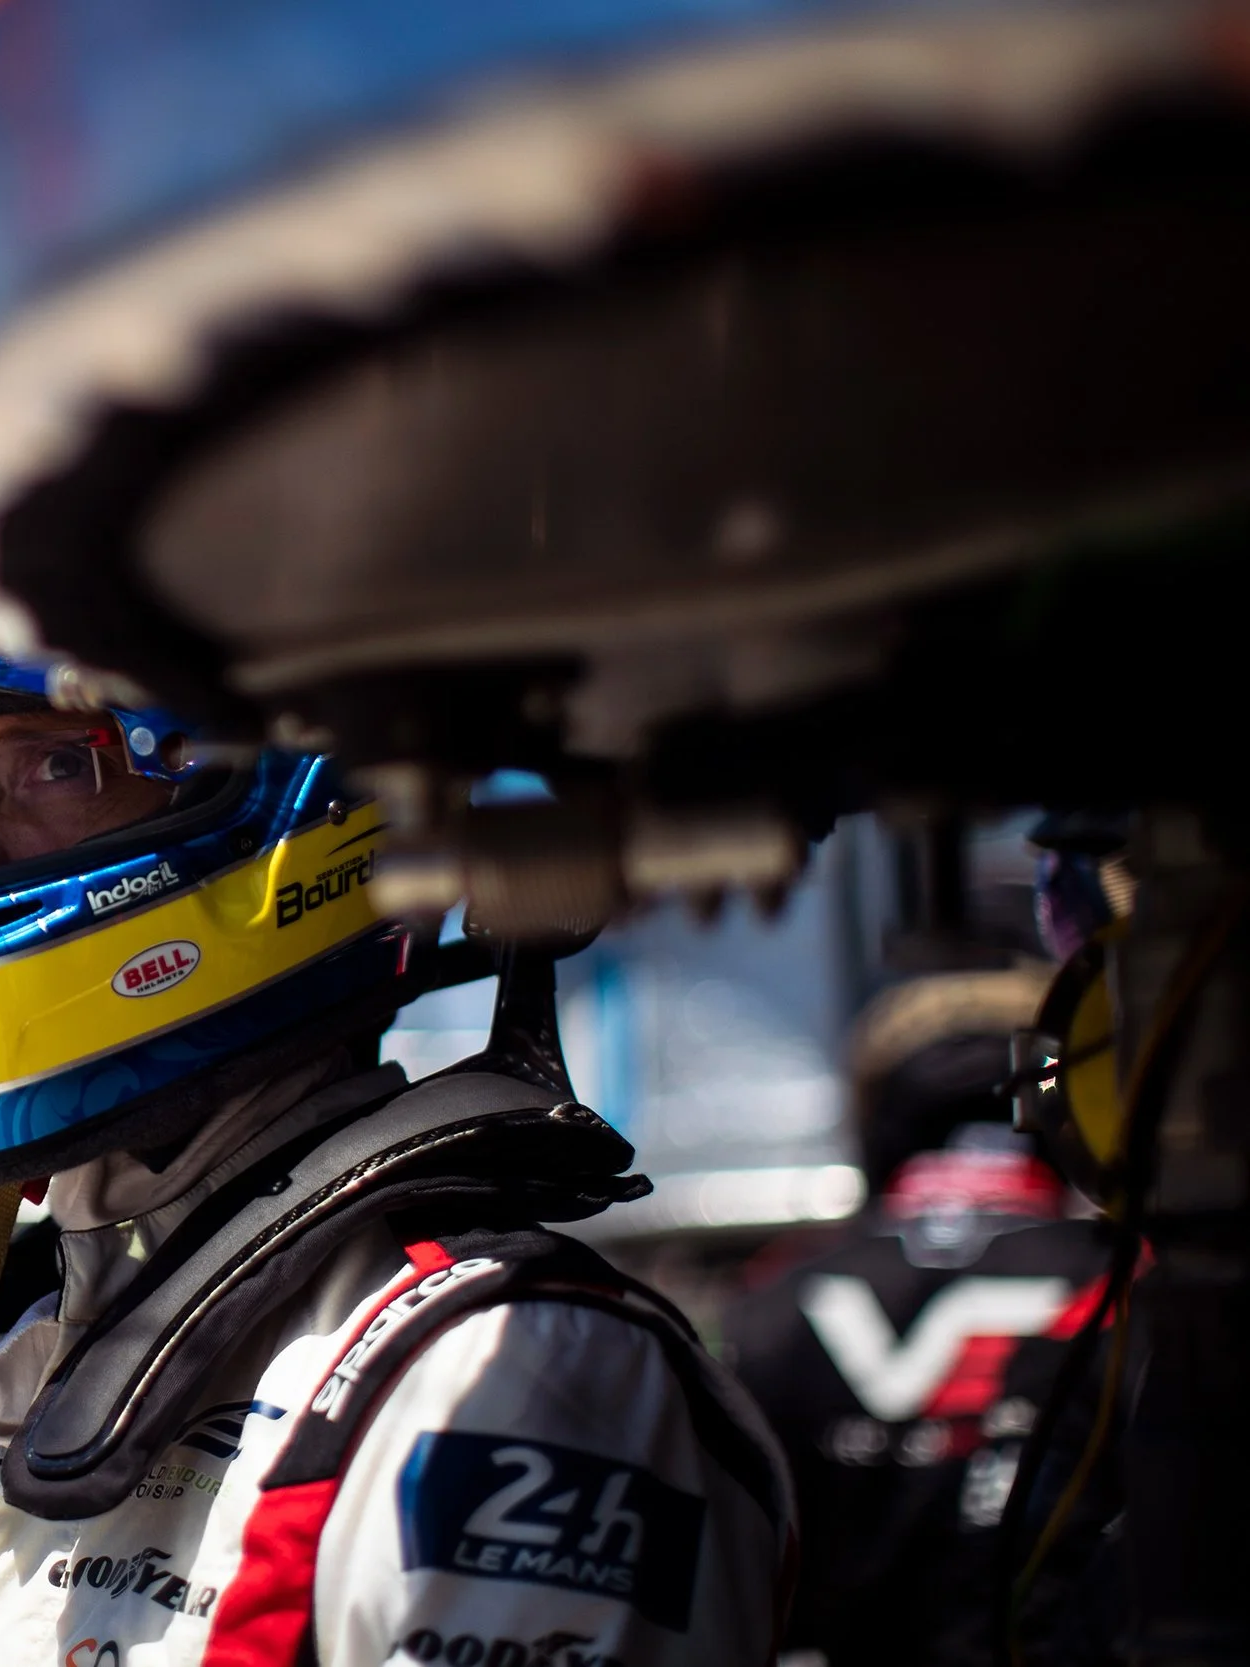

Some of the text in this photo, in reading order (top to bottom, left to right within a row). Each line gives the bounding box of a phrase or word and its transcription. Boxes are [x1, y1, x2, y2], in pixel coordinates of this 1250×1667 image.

[86, 861, 178, 911] Indocil
[276, 849, 375, 929] Bourd
[122, 948, 190, 990] BELL
[462, 1445, 643, 1563] 24h
[453, 1540, 634, 1594] LE MANS
